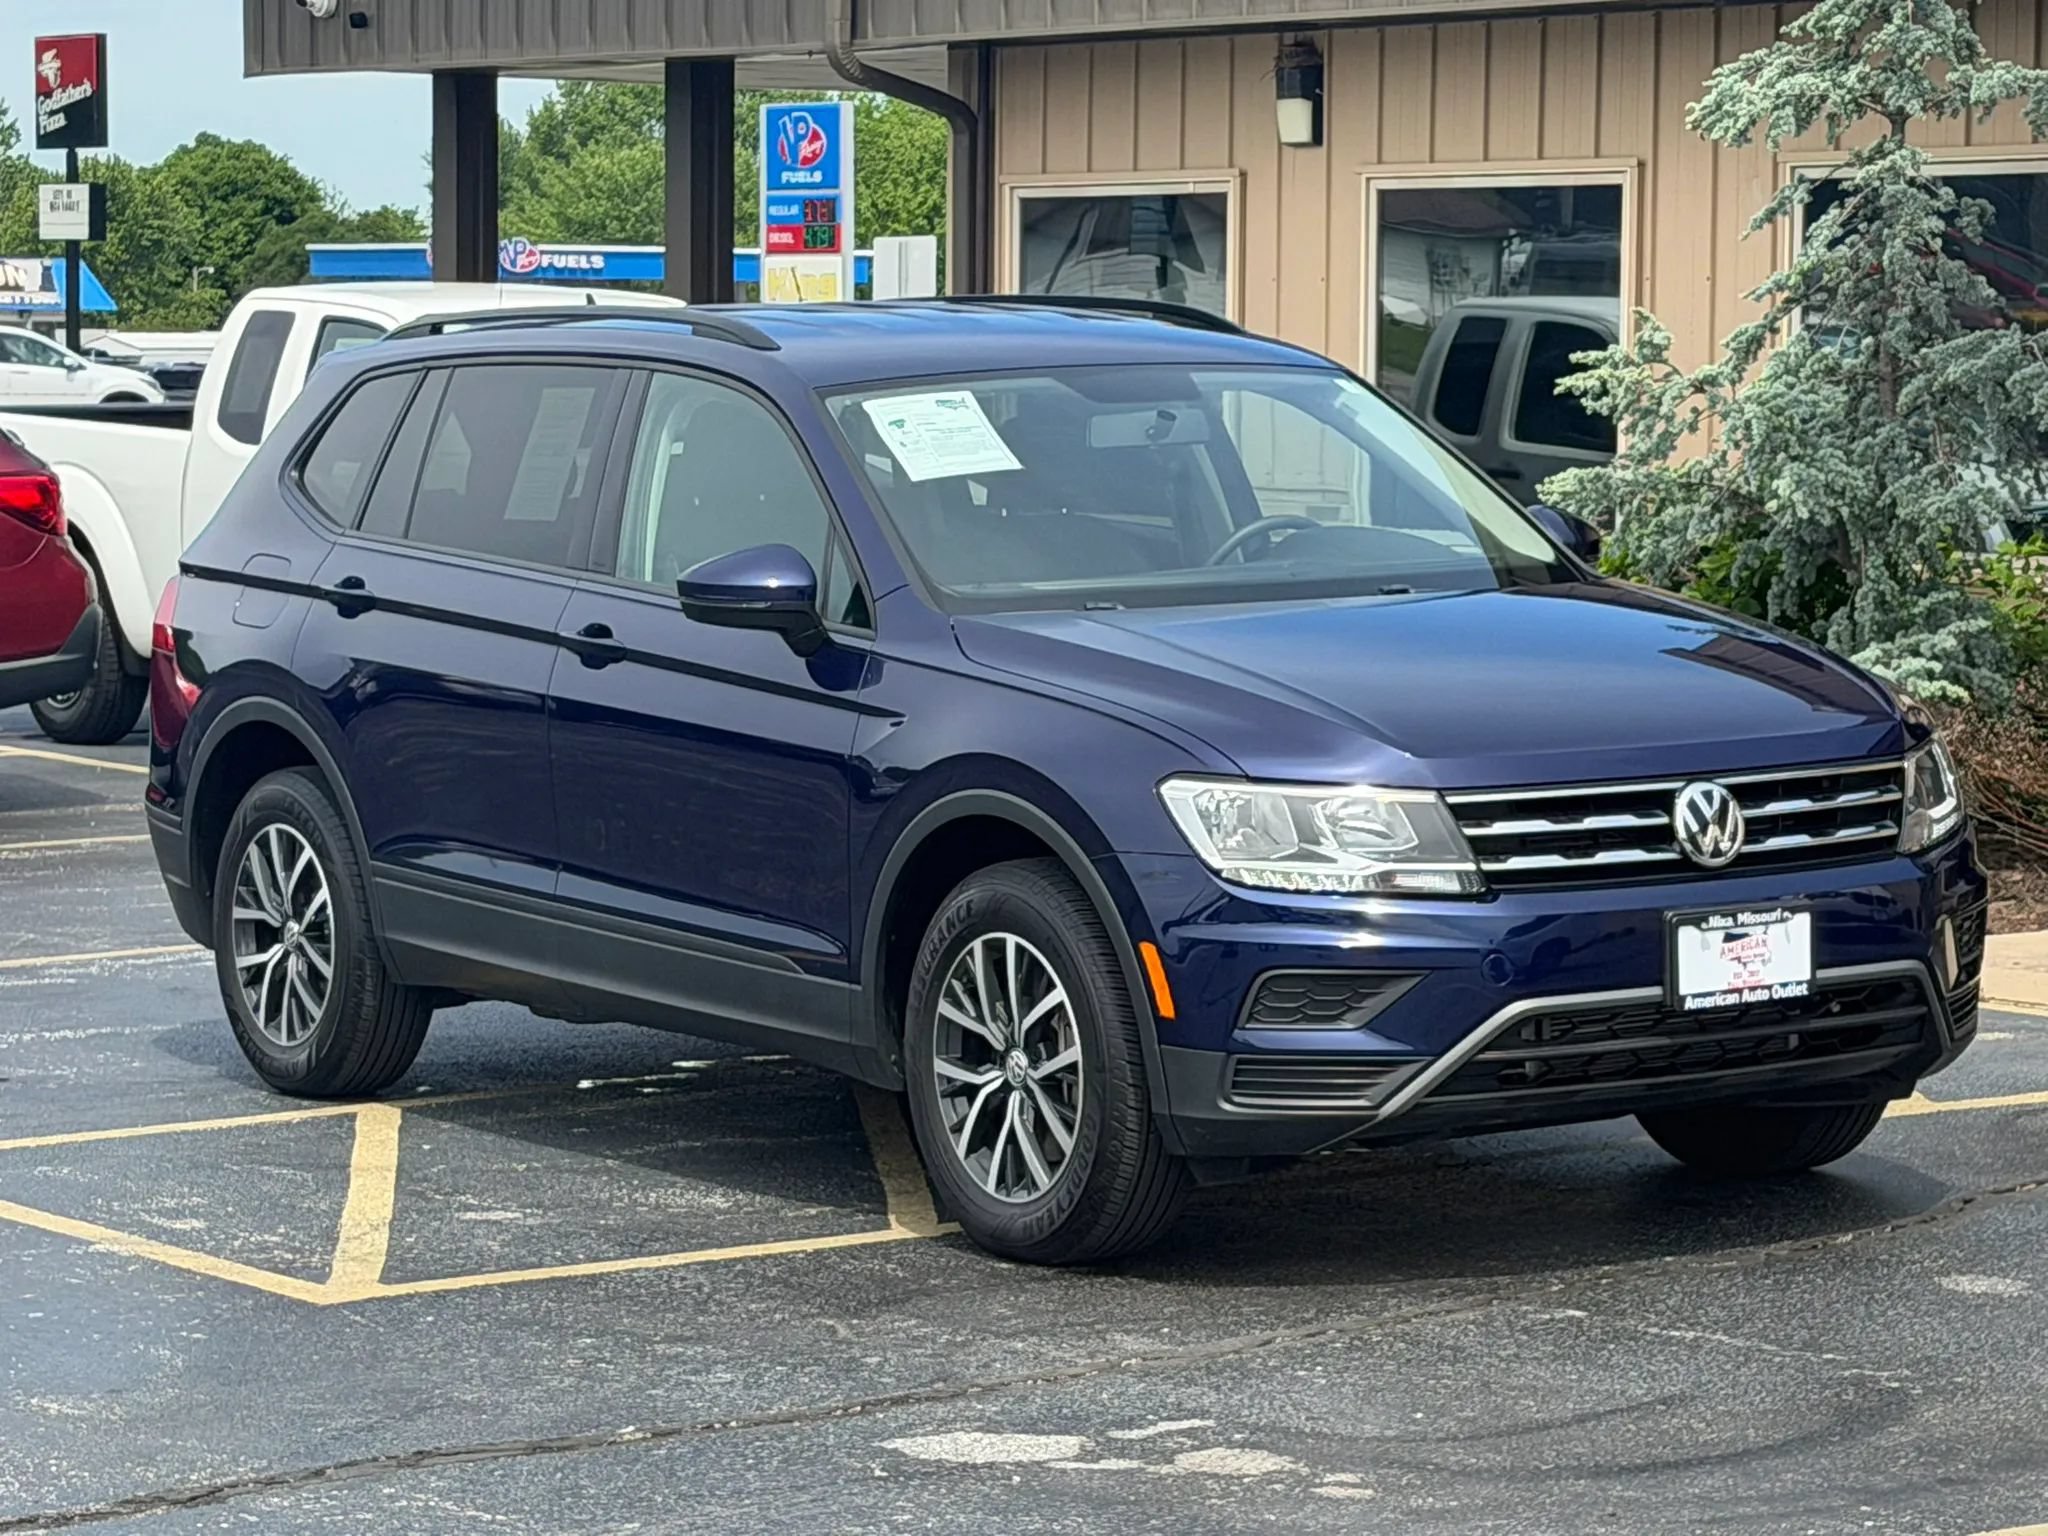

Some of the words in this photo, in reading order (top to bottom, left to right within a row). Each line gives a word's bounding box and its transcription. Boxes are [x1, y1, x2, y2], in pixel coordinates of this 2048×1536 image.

[37, 77, 93, 116] Godfather's
[39, 112, 68, 136] Pizza
[781, 170, 823, 184] FUELS
[768, 231, 795, 244] DIESEL
[541, 254, 605, 269] FUELS
[1737, 908, 1782, 925] Missouri
[1720, 937, 1768, 959] AMERICAN
[1684, 993, 1740, 1010] American
[1741, 988, 1770, 1003] Auto
[1772, 982, 1809, 999] Outlet
